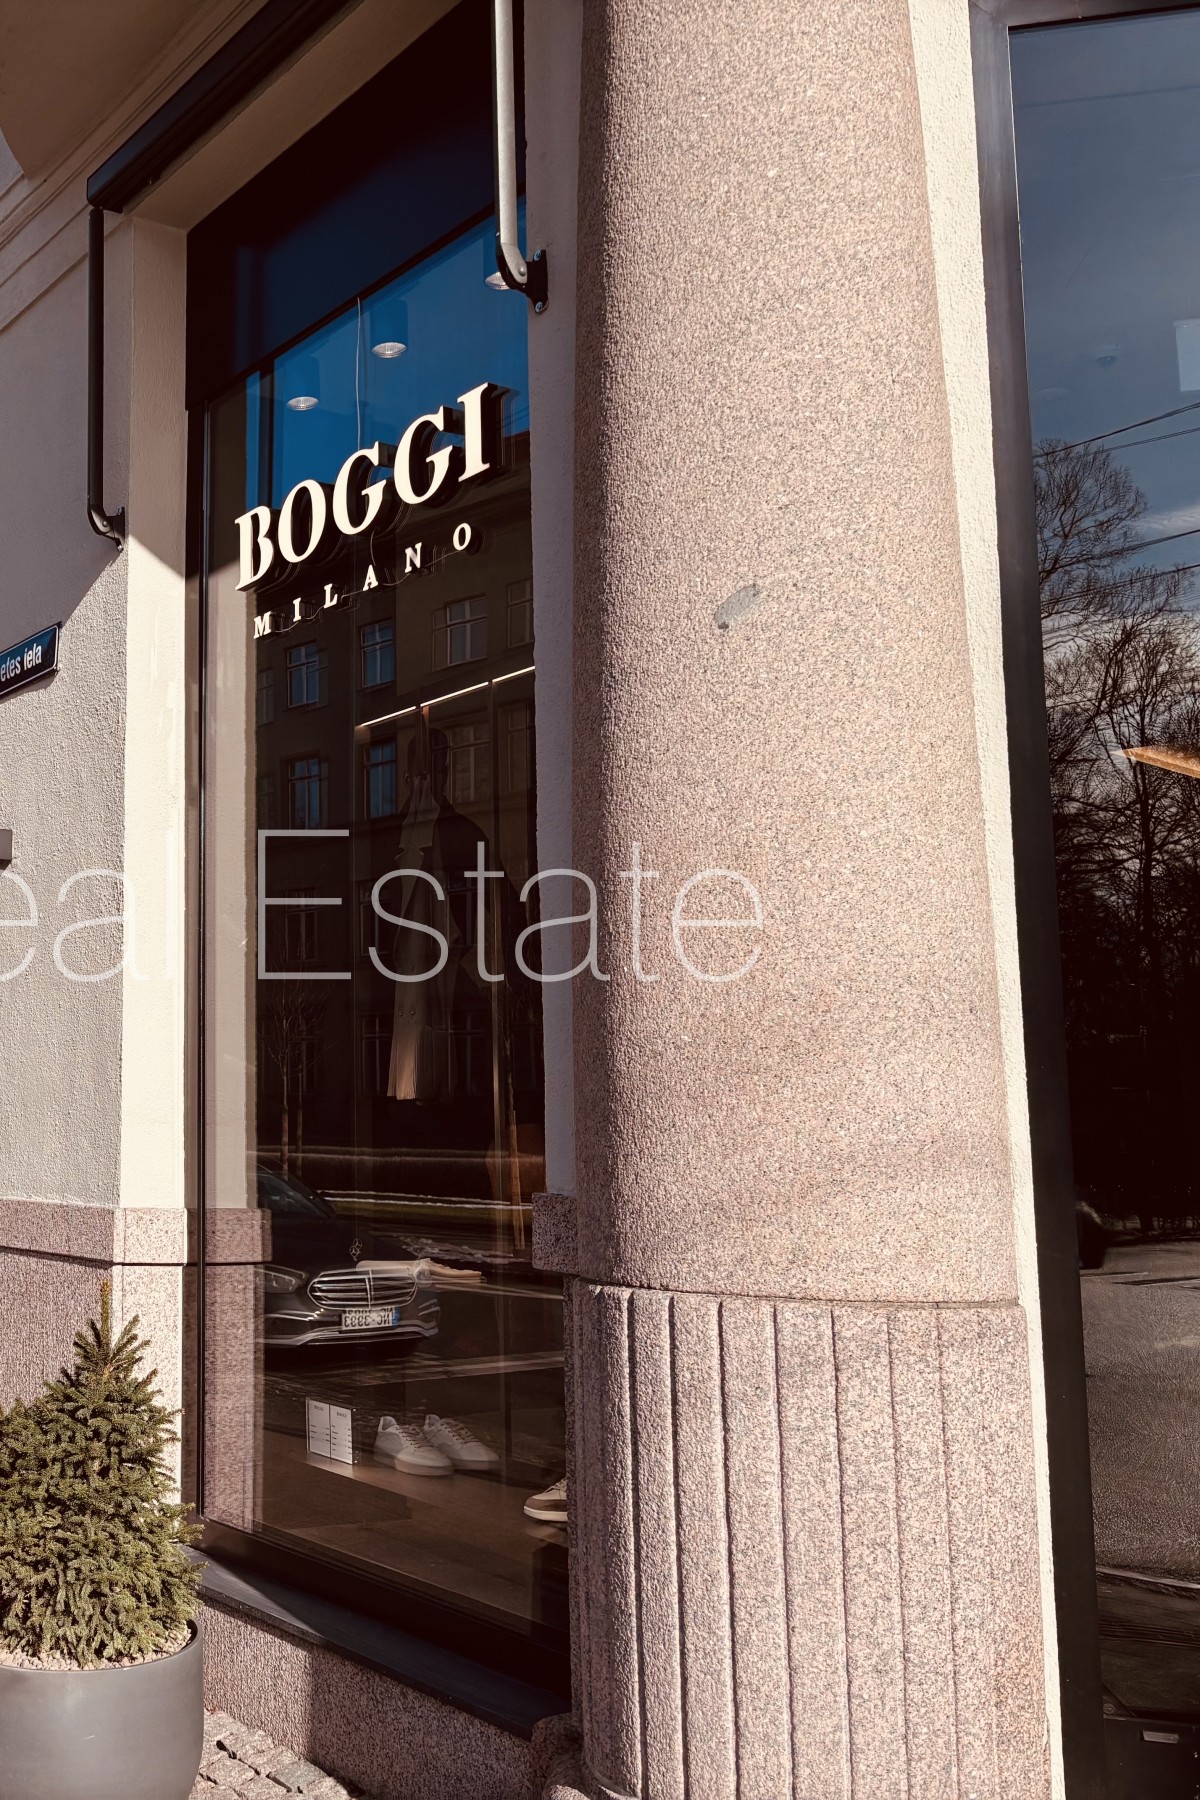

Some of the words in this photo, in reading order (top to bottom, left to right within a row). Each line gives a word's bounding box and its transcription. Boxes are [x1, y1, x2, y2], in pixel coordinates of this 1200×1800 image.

[234, 382, 490, 591] BOGGI
[253, 522, 472, 639] MILANO
[23, 642, 42, 671] iela
